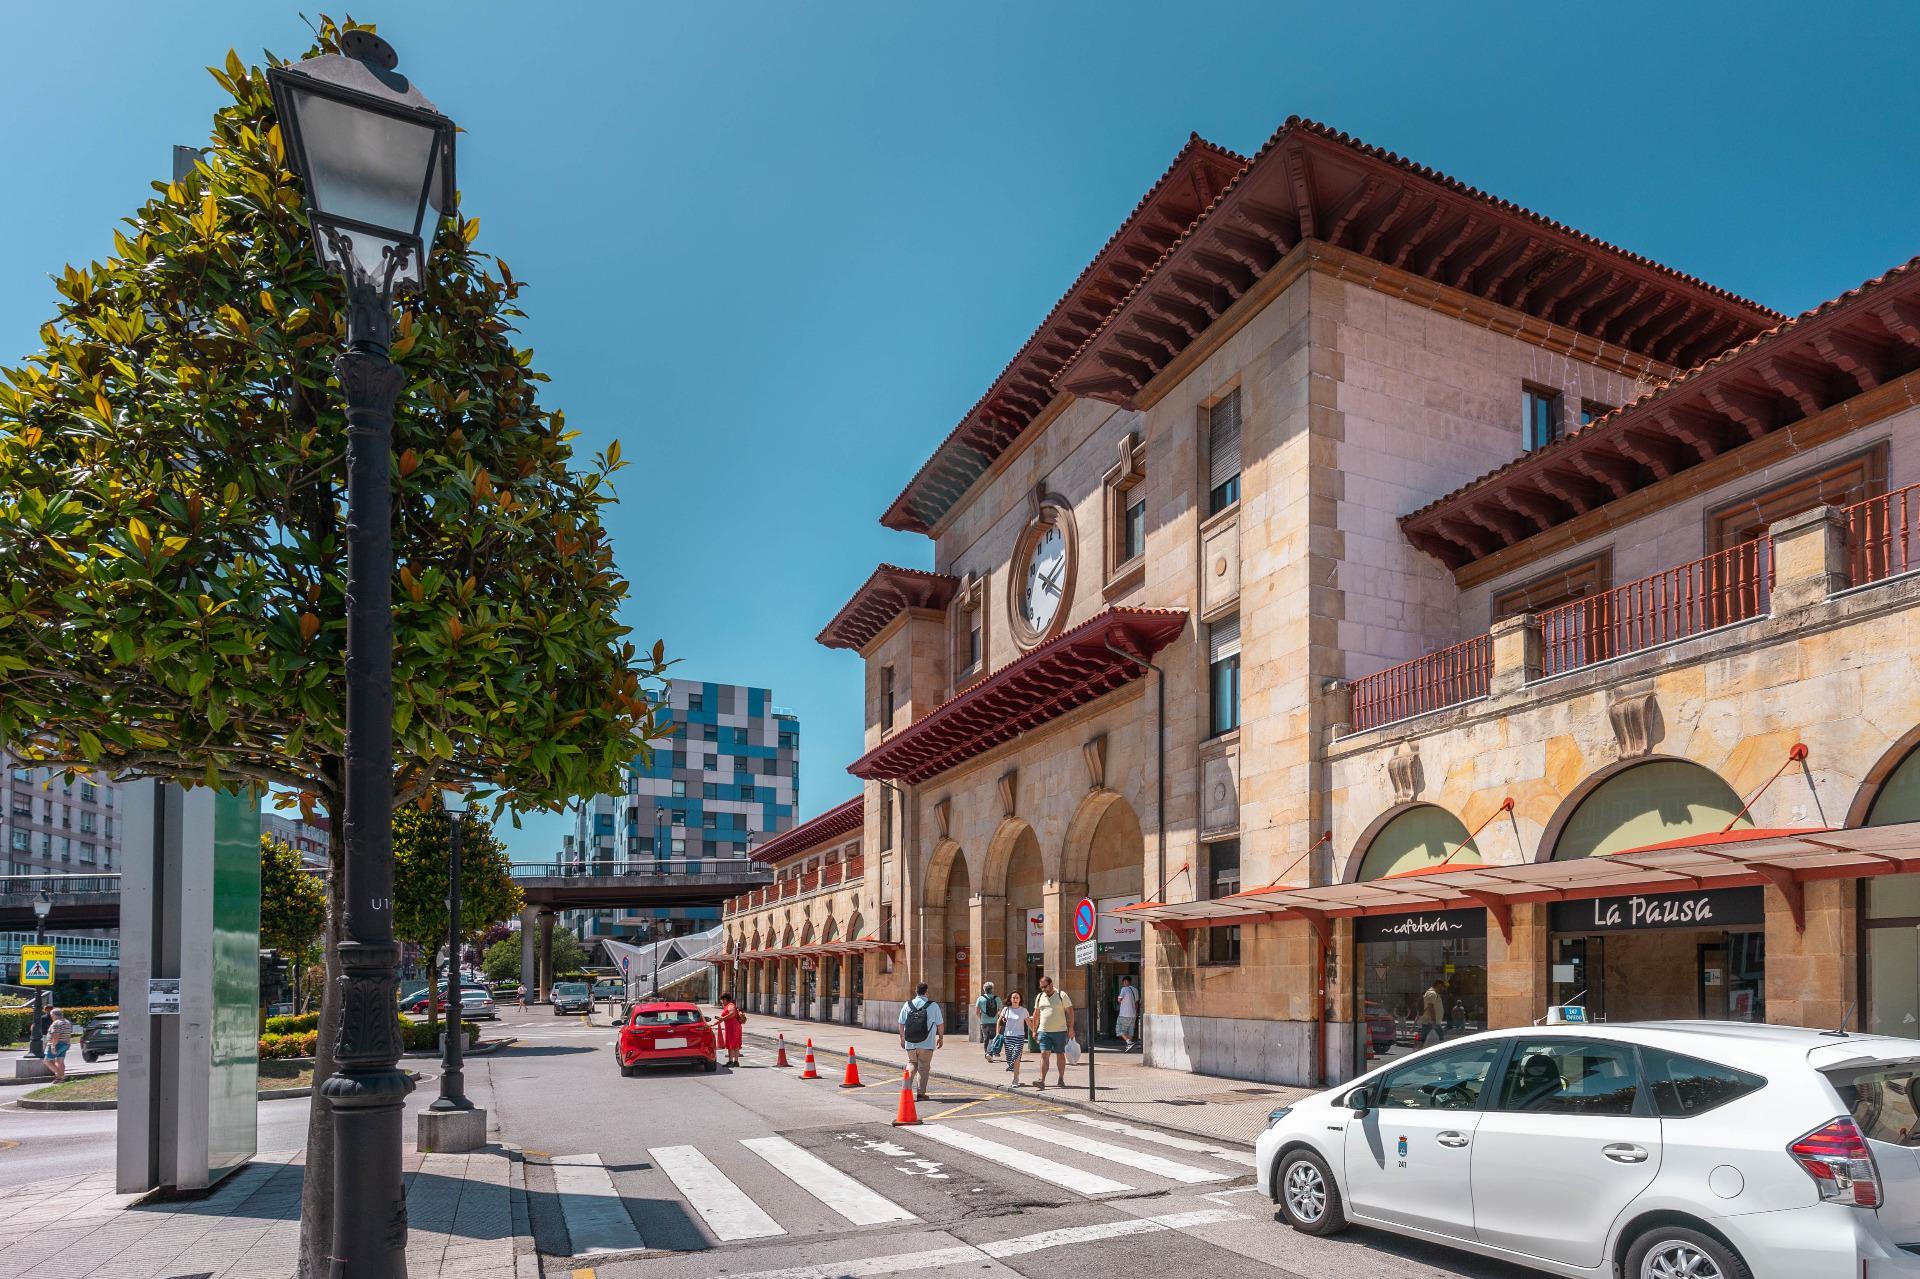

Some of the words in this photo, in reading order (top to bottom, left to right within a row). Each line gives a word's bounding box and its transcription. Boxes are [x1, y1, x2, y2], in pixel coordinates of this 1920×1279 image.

[1046, 528, 1053, 544] 12
[1037, 542, 1042, 556] 11
[1030, 564, 1036, 578] 10
[1027, 588, 1032, 600] 9
[1594, 898, 1622, 926] La
[1628, 896, 1713, 925] Pausa
